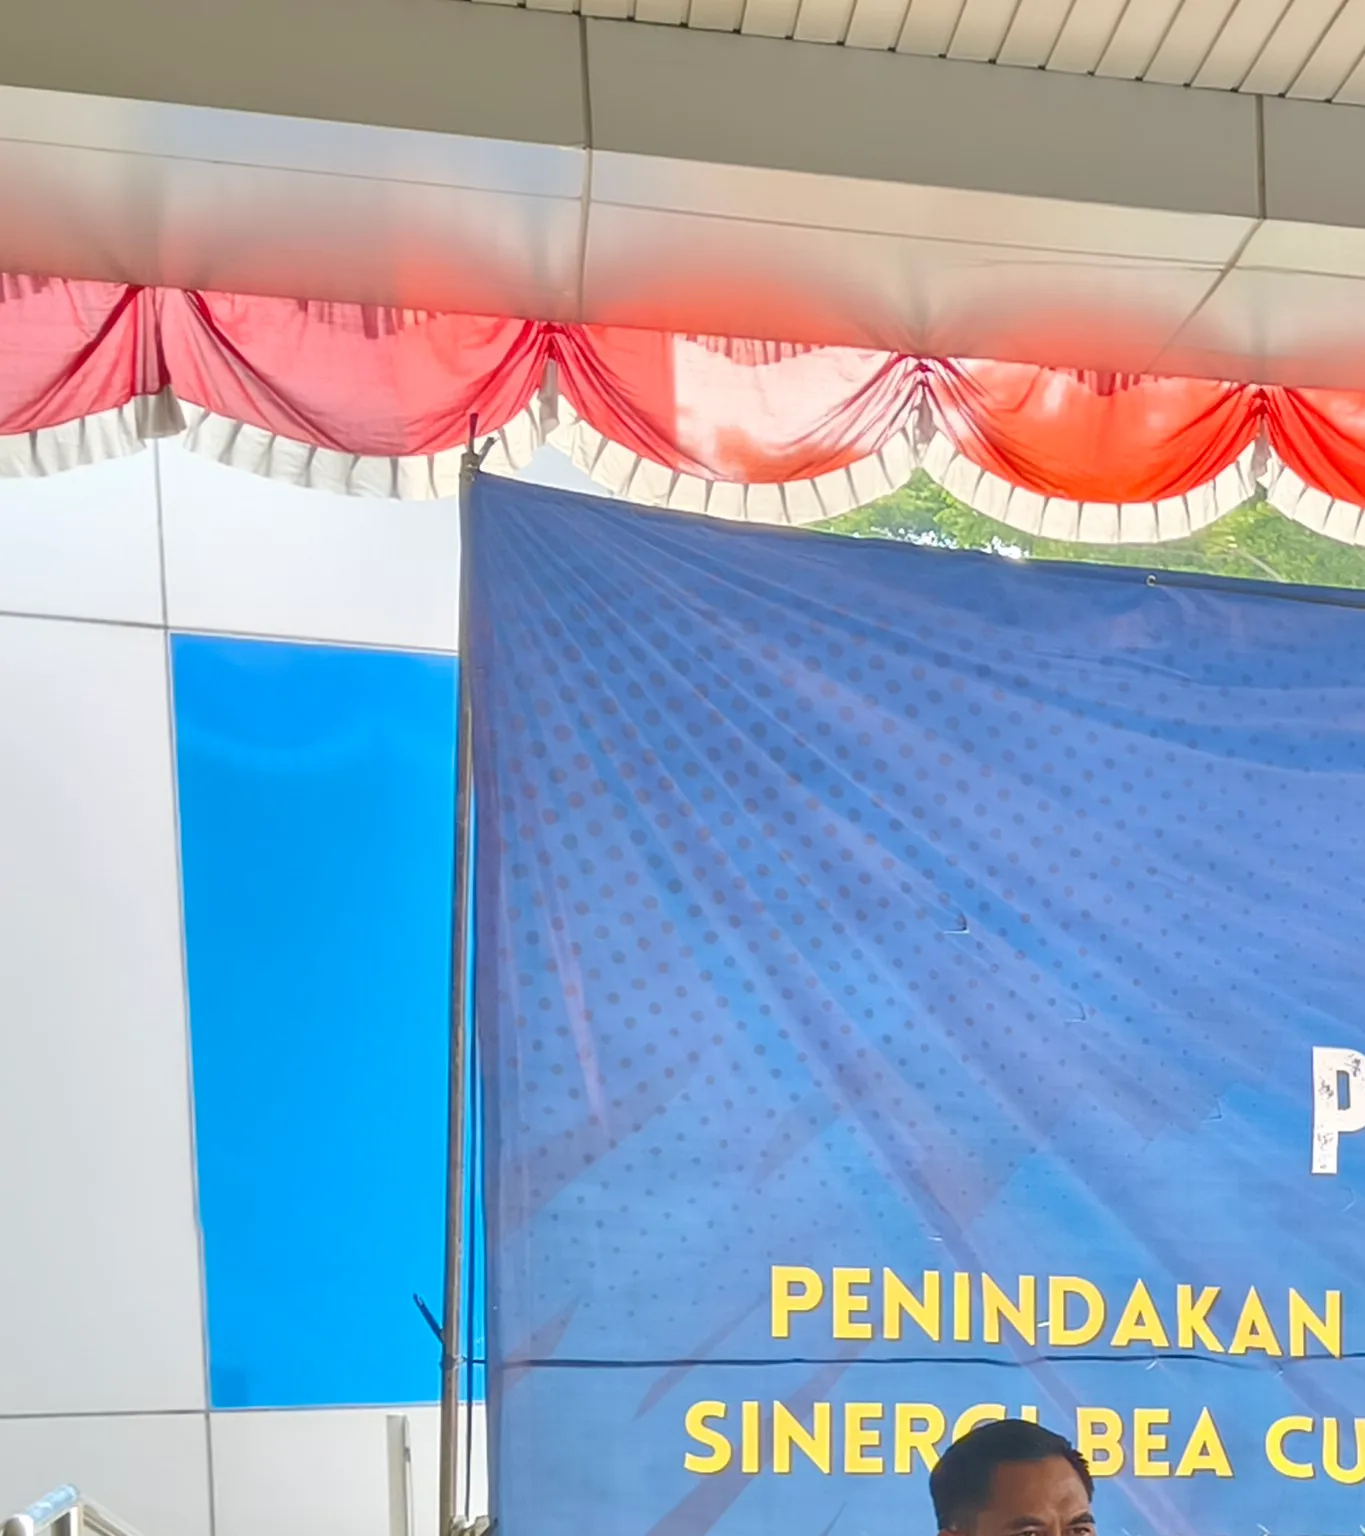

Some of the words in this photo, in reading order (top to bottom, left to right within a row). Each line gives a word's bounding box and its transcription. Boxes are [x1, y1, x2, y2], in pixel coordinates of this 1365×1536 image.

[771, 1266, 1342, 1358] PENINDAKAN
[684, 1401, 1038, 1475] SINER
[1076, 1407, 1234, 1478] BEA
